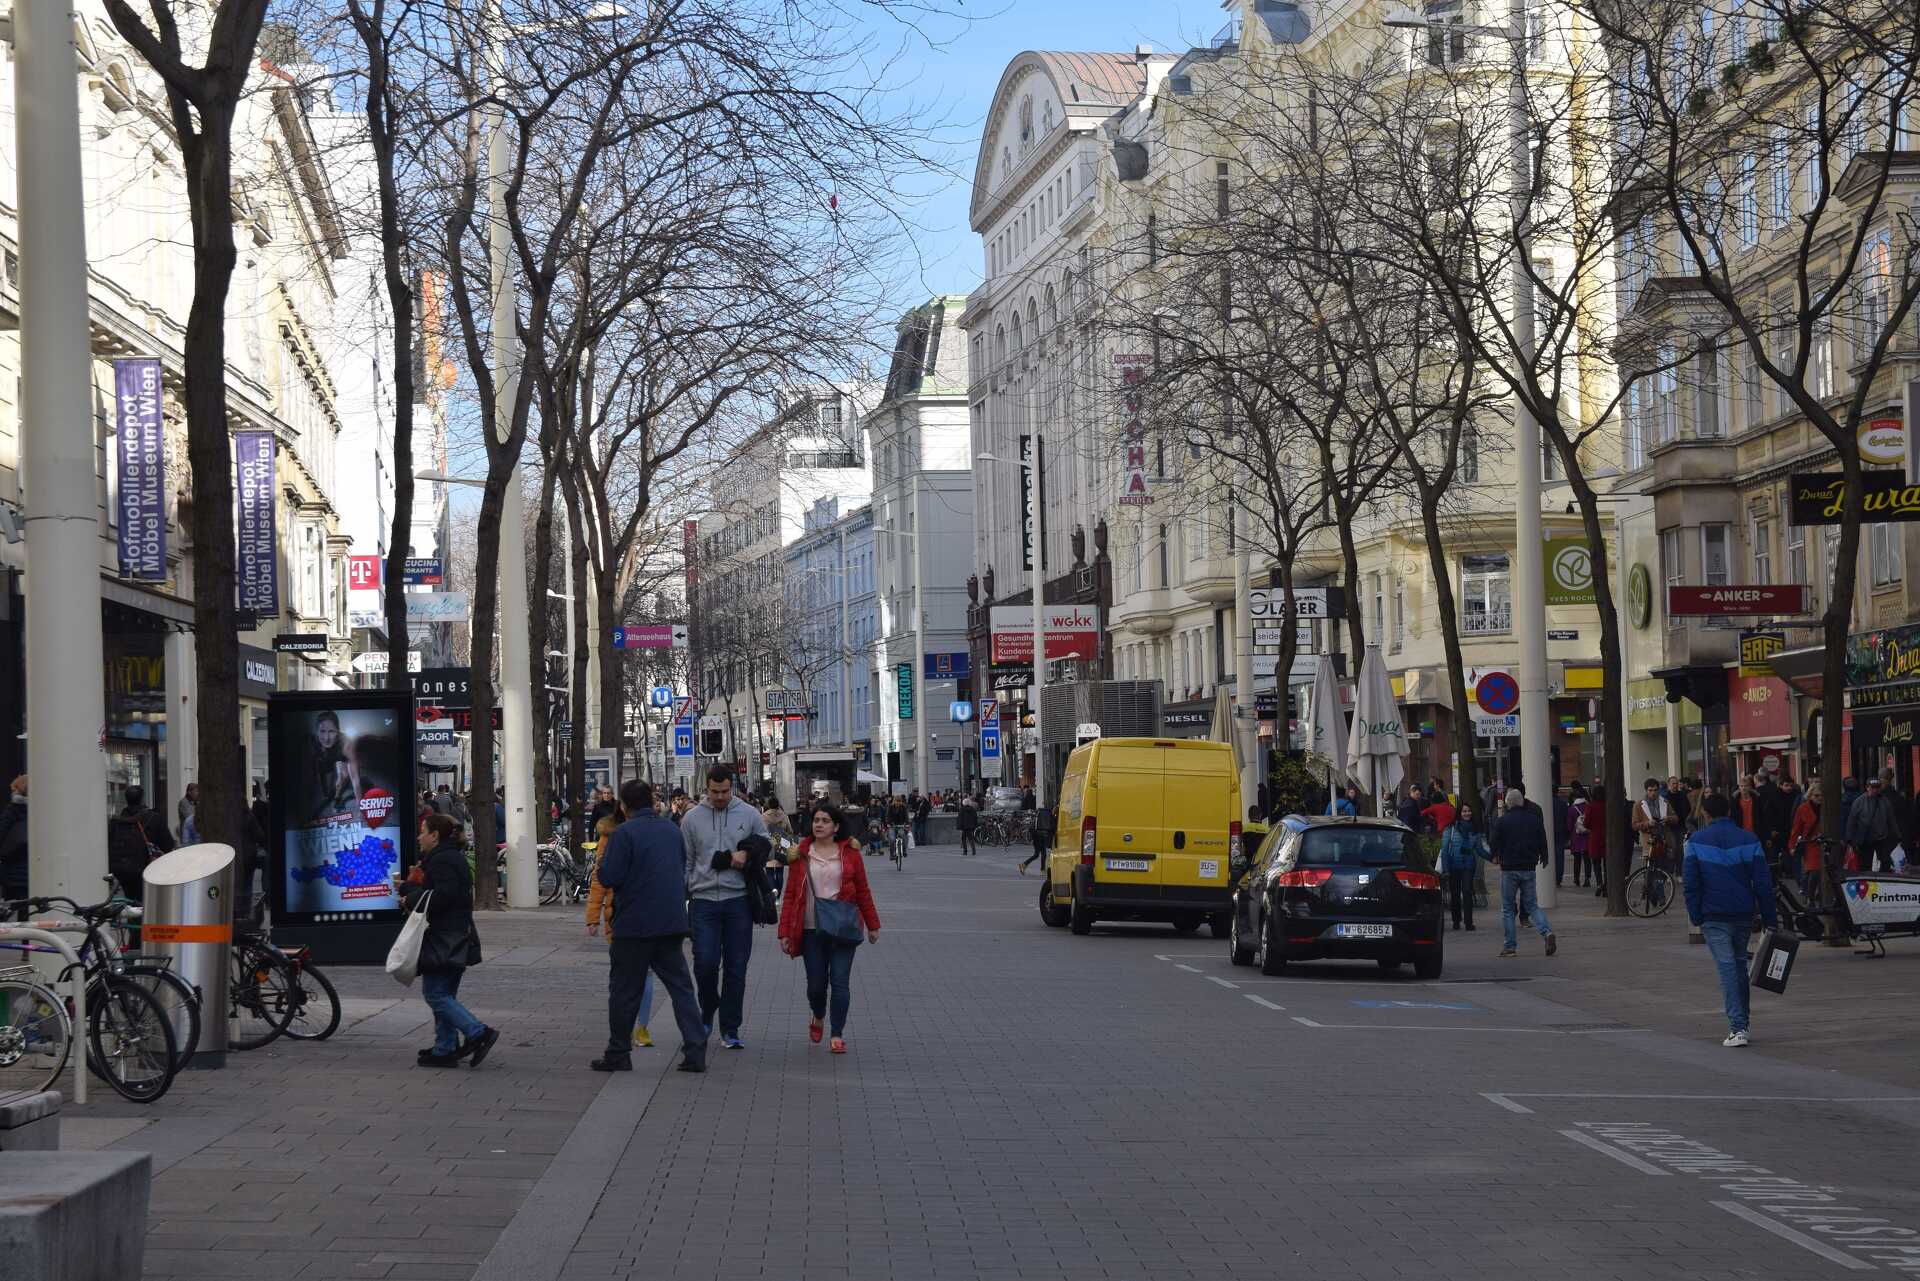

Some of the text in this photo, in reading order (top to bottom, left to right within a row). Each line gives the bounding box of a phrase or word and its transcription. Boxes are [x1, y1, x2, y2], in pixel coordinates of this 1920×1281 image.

[139, 366, 161, 573] Möbel Museum Wien
[122, 394, 140, 573] Hofmobiliendepot
[257, 437, 274, 611] Möbel Museum Wien
[243, 461, 258, 611] Hofmobiliendepot
[351, 560, 371, 584] T
[1713, 590, 1761, 602] ANKER
[998, 634, 1073, 643] Gesundhezentrum
[1258, 630, 1309, 640] seideker
[279, 642, 325, 650] CALZEDONIA
[363, 653, 418, 662] PENN
[1886, 638, 1920, 680] Dura
[365, 662, 416, 671] HARA
[900, 665, 912, 718] WEEKDAY
[1747, 687, 1768, 703] ANKER
[1163, 714, 1206, 723] DIESEL
[359, 797, 394, 811] SERVUS
[366, 807, 387, 818] WIEN
